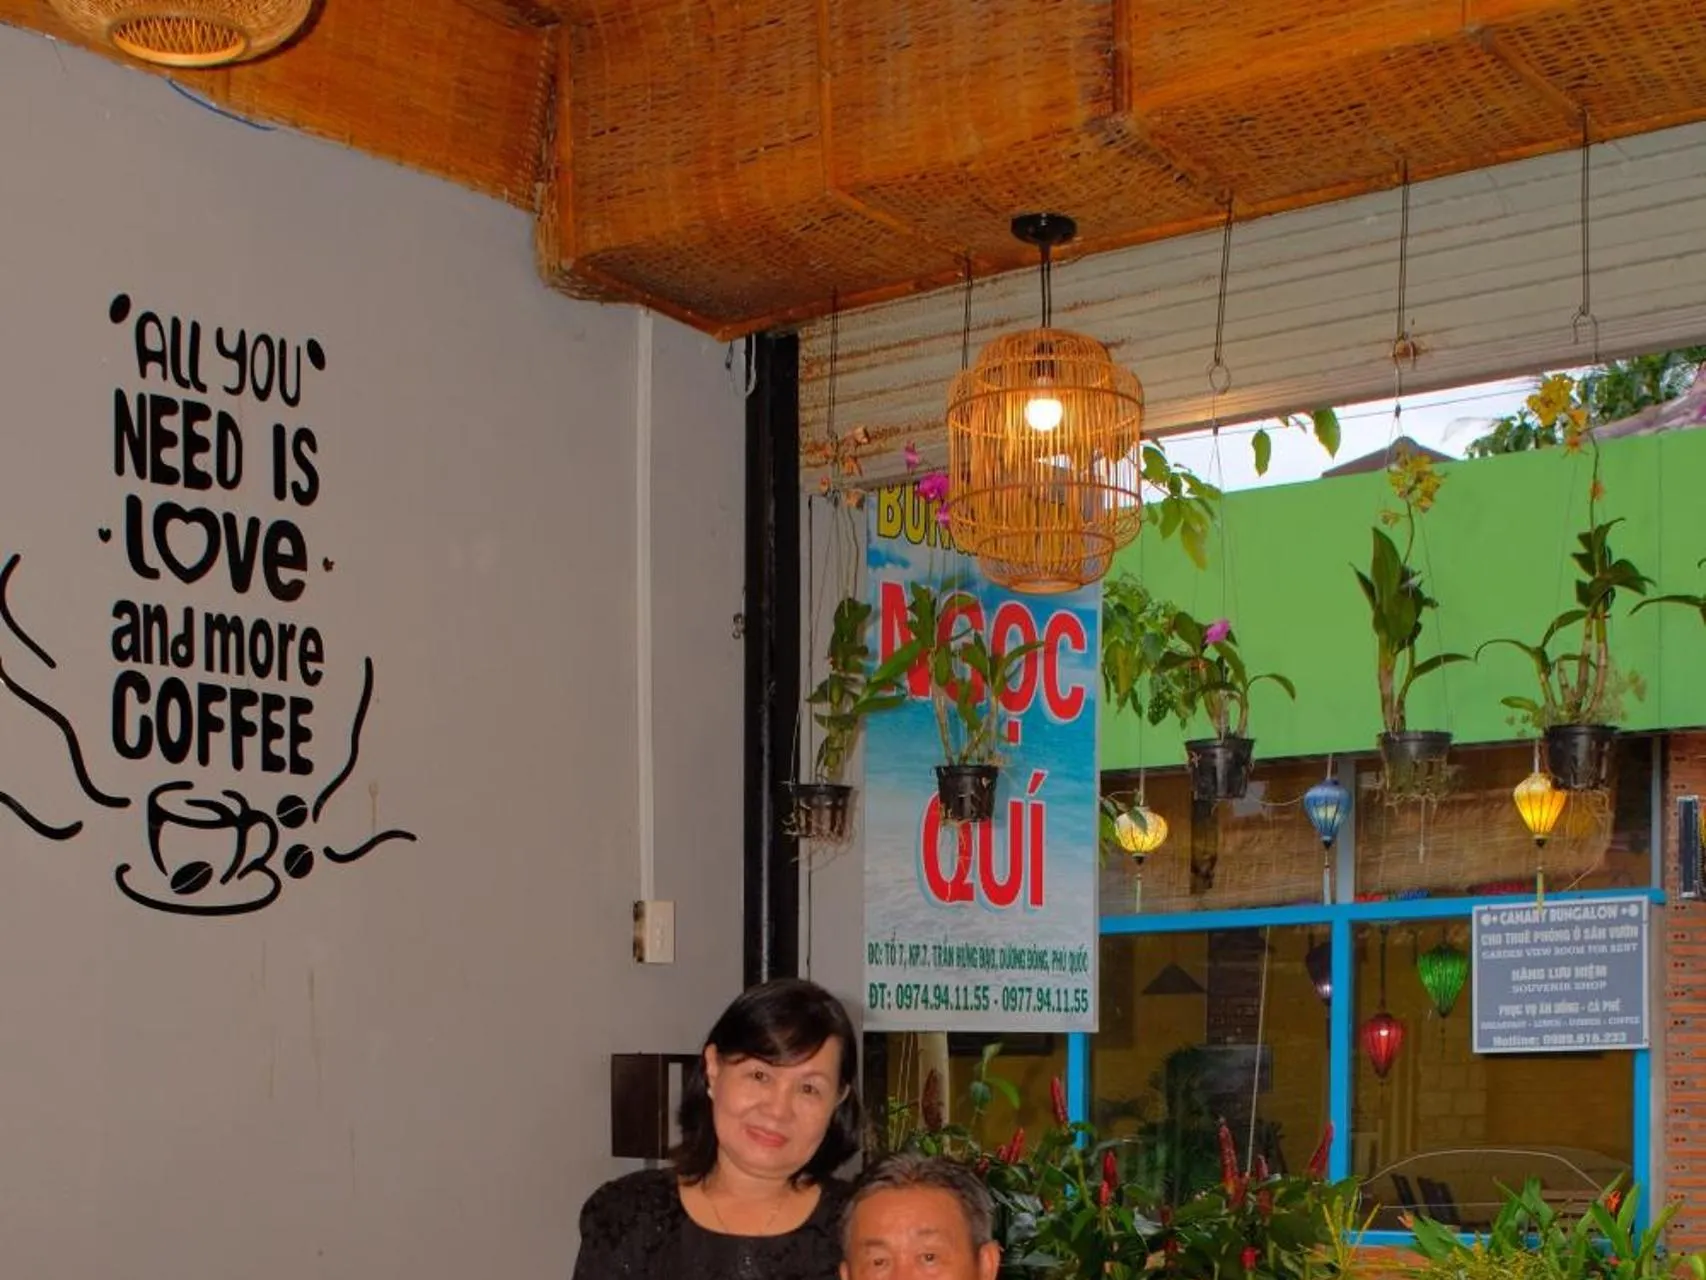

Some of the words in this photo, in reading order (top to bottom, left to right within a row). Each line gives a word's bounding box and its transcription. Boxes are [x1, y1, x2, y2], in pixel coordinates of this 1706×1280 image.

[113, 388, 244, 491] NEED
[272, 423, 320, 506] IS
[111, 600, 195, 669] and
[204, 611, 325, 687] more
[111, 670, 314, 776] COFFEE
[920, 770, 1045, 908] QUÍ
[1550, 904, 1618, 923] BUNGALOW
[868, 982, 892, 1010] ĐT:
[895, 983, 990, 1011] 0974.94.11.55
[1002, 986, 1089, 1013] 0977.94.11.55
